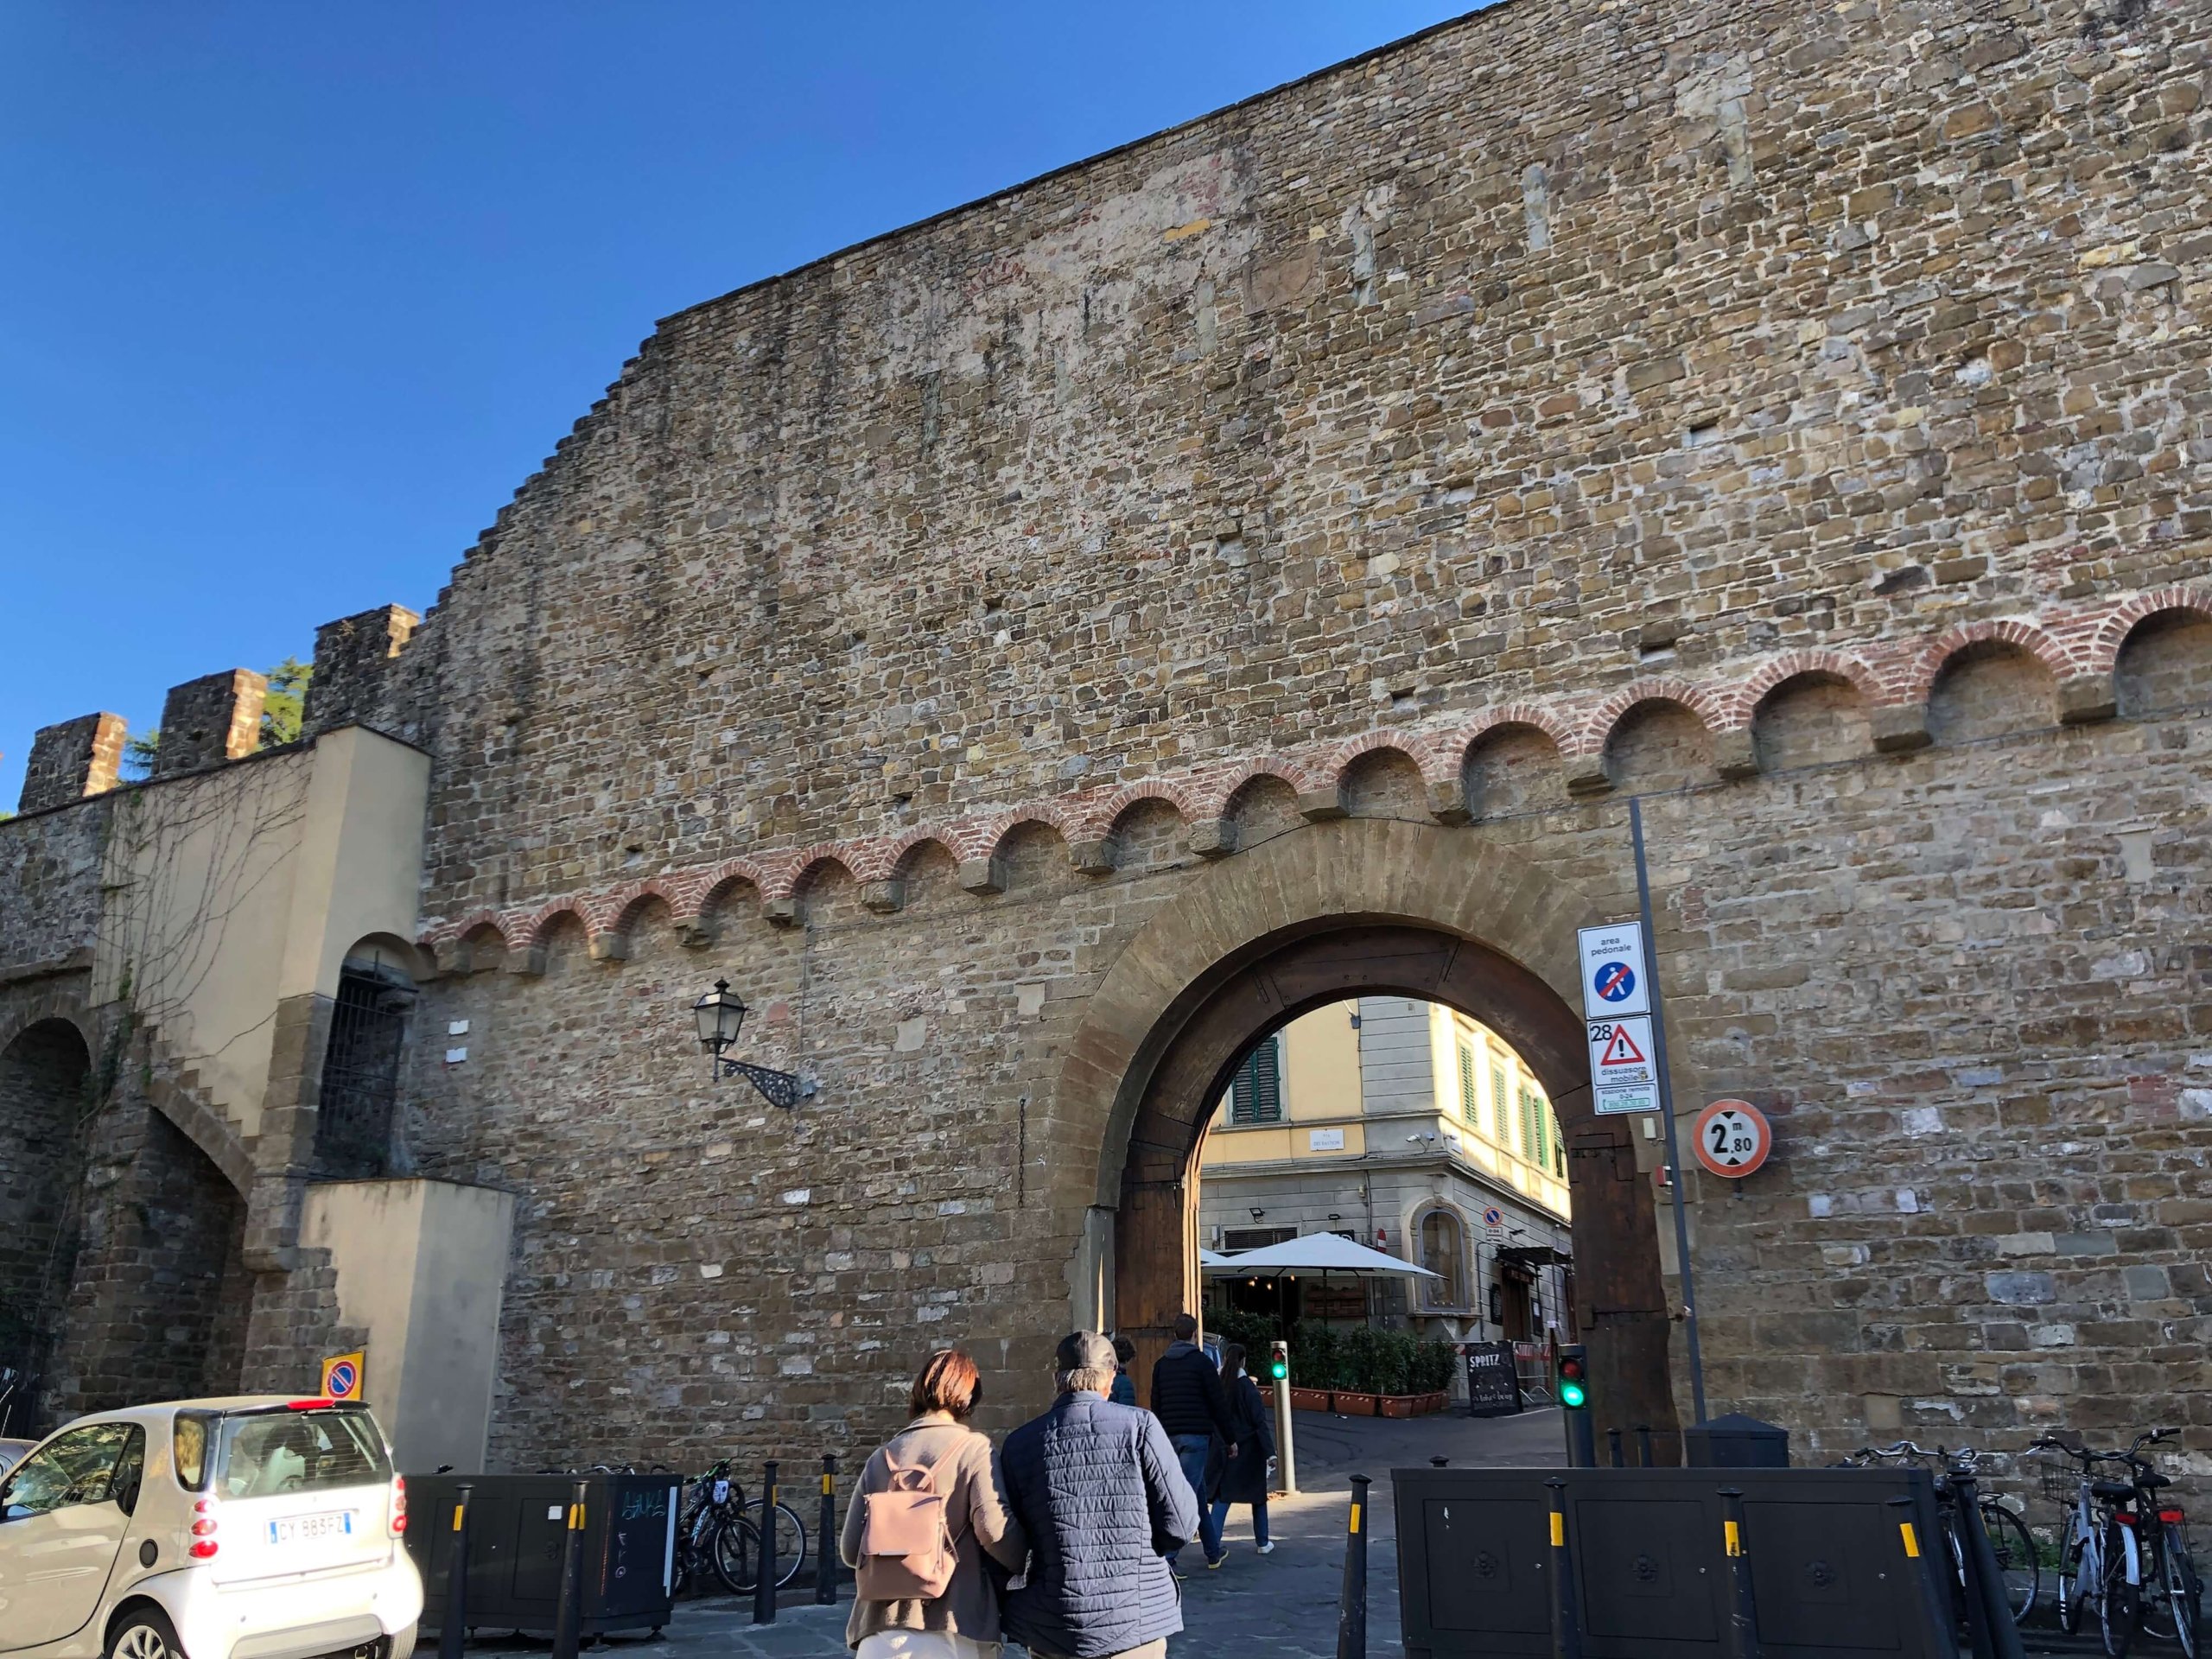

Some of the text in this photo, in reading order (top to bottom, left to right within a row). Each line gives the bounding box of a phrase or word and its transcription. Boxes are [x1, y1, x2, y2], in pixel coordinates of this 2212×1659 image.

[1600, 936, 1621, 946] area
[1591, 944, 1632, 957] pedonale
[1590, 1025, 1613, 1042] 28
[1601, 1066, 1646, 1076] dissuasore
[1611, 1074, 1638, 1084] mobile
[1732, 1122, 1742, 1131] m
[1470, 1354, 1501, 1368] SPRITZ
[279, 1522, 295, 1540] CY
